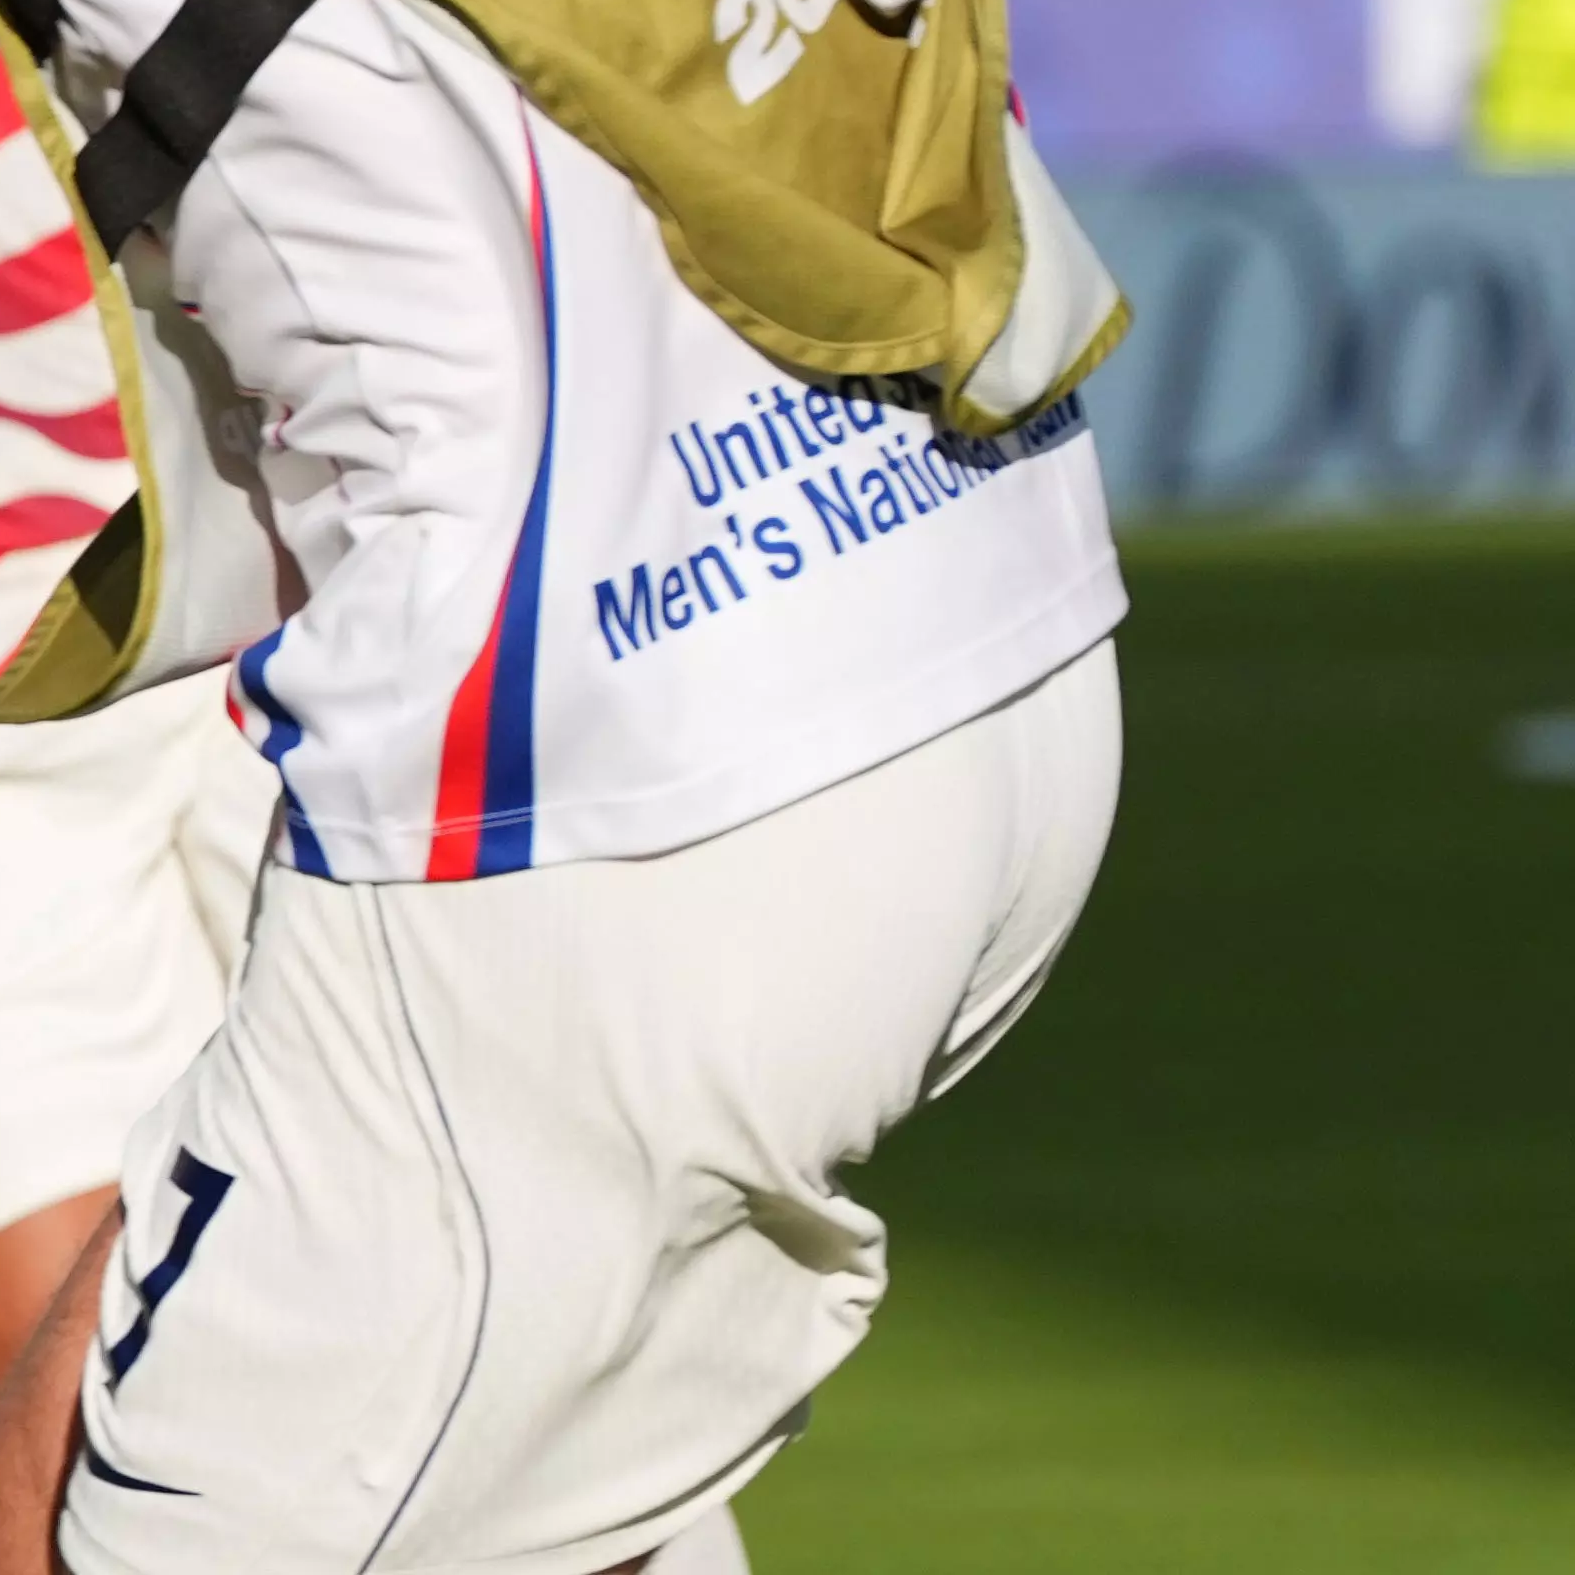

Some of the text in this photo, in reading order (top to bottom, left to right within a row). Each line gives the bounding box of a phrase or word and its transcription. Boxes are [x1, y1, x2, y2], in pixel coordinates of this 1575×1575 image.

[670, 374, 884, 508] United
[593, 514, 803, 661] Men's
[105, 1144, 237, 1398] 7
